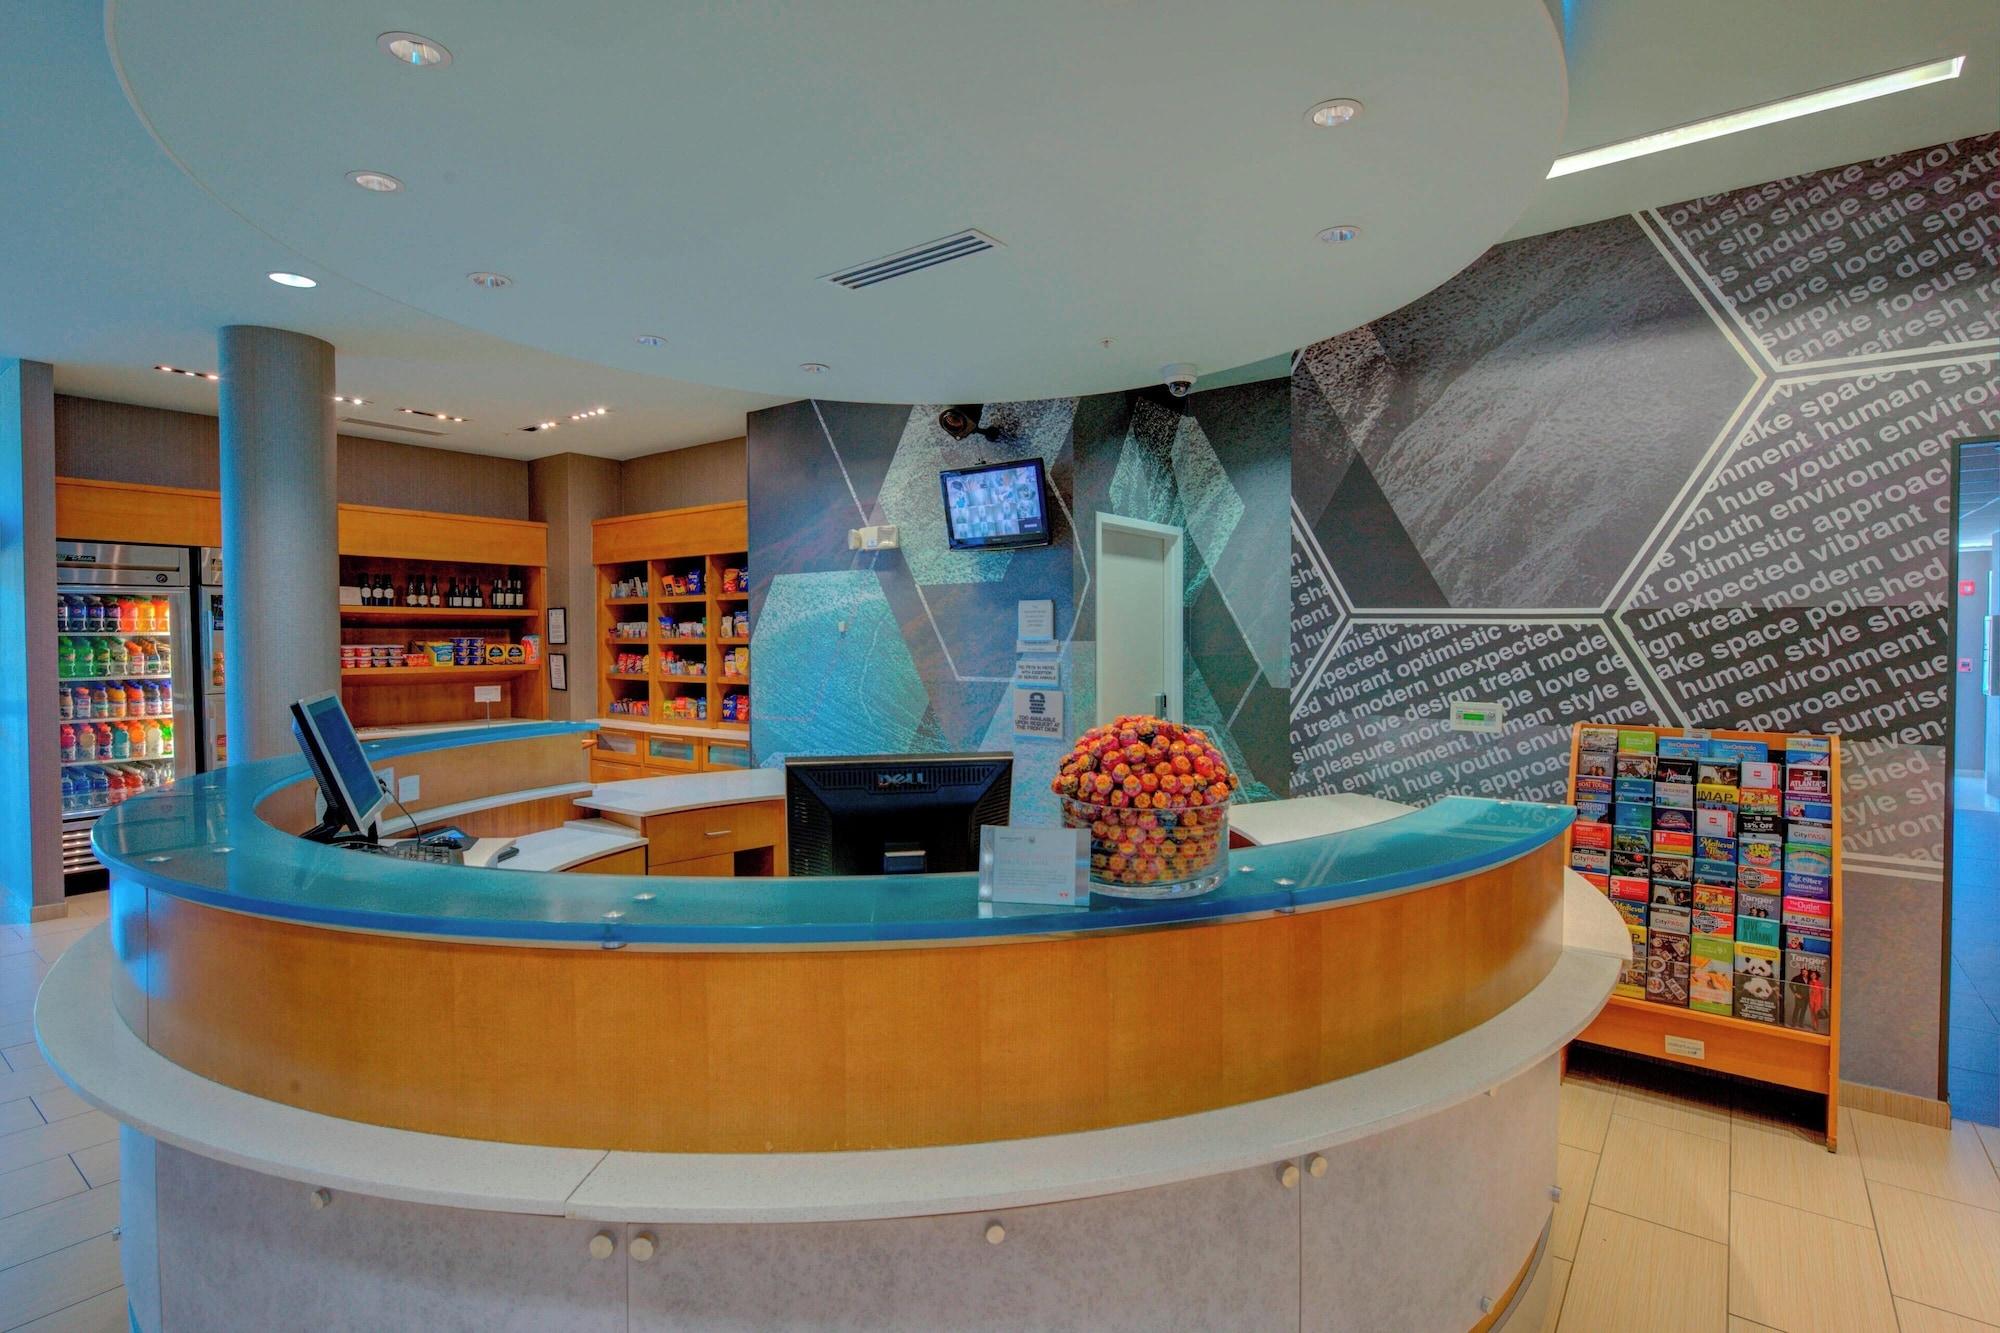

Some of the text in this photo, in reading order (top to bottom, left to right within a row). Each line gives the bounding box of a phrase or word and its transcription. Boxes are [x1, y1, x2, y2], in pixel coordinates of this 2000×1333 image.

[1719, 222, 1763, 255] sip
[1770, 165, 1864, 225] shake
[1742, 198, 1861, 269] indulge
[1850, 193, 1926, 240] little
[1832, 225, 1916, 280] local
[1876, 262, 1977, 319] focus
[1760, 275, 1888, 349] surprise
[1736, 413, 1793, 451] ake
[1799, 371, 1896, 418] space
[1814, 380, 1933, 441] human
[1680, 514, 1764, 563] youth
[1769, 420, 1976, 520] environment
[1716, 480, 1776, 514] hue
[1779, 437, 1872, 492] youth
[1639, 549, 1804, 631] unexpected
[1809, 504, 1928, 562] vibrant
[1663, 525, 1806, 592] optimistic
[1688, 600, 1758, 640] treat
[1761, 555, 1884, 612] modern
[1710, 616, 1801, 659] space
[1804, 556, 1949, 631] polished
[1292, 634, 1608, 765] simple love design treat mode
[1303, 709, 1349, 738] treat
[1351, 680, 1429, 719] modern
[1433, 624, 1564, 688] unexpected
[1324, 667, 1394, 707] vibrant
[1397, 624, 1502, 677] optimistic
[1676, 654, 1779, 699] human
[1784, 625, 1861, 662] style
[1735, 654, 1948, 735] approach hue
[1736, 625, 1937, 707] environment
[1312, 739, 1395, 783] pleasure
[1398, 718, 1451, 748] more
[1536, 667, 1591, 697] love
[1342, 733, 1471, 791] environment
[1558, 683, 1619, 714] style
[879, 772, 928, 786] DELL
[1402, 769, 1444, 795] hue
[1447, 746, 1512, 783] youth
[1790, 780, 1826, 788] ATLANTA'S
[1741, 893, 1774, 905] Tanger
[1791, 953, 1827, 965] Tanger
